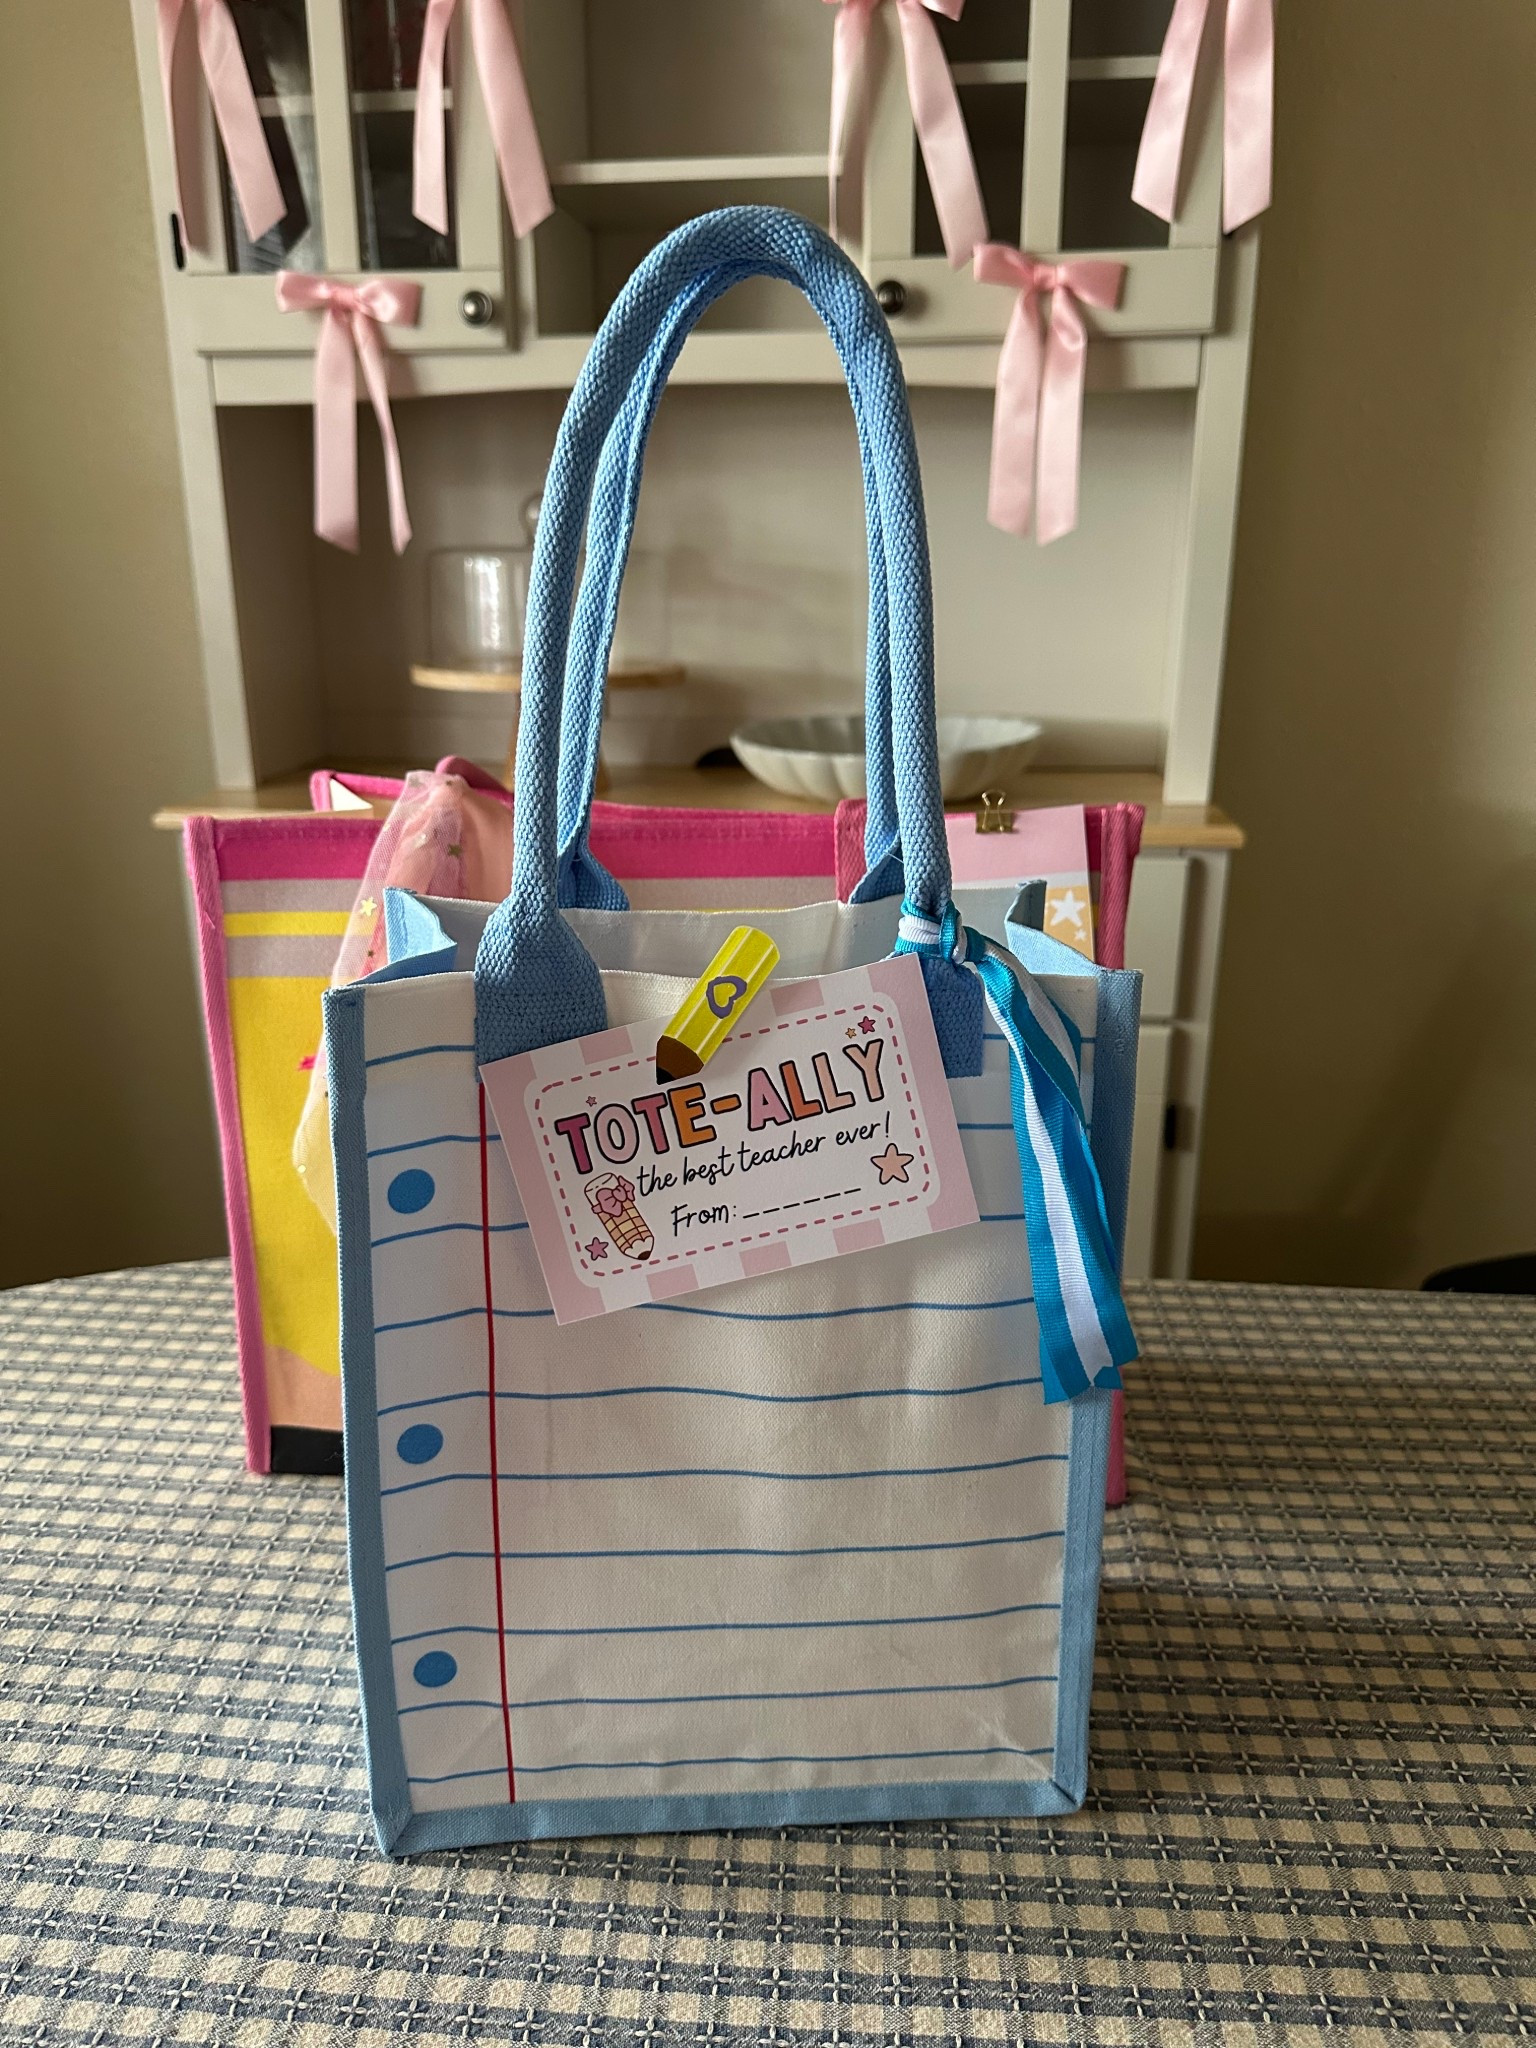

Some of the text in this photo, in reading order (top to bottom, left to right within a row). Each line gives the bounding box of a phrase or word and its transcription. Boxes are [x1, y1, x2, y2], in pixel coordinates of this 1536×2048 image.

[554, 1038, 884, 1175] TOTE-ALLY
[637, 1110, 892, 1197] the best teacher ever!
[671, 1203, 738, 1237] From:
